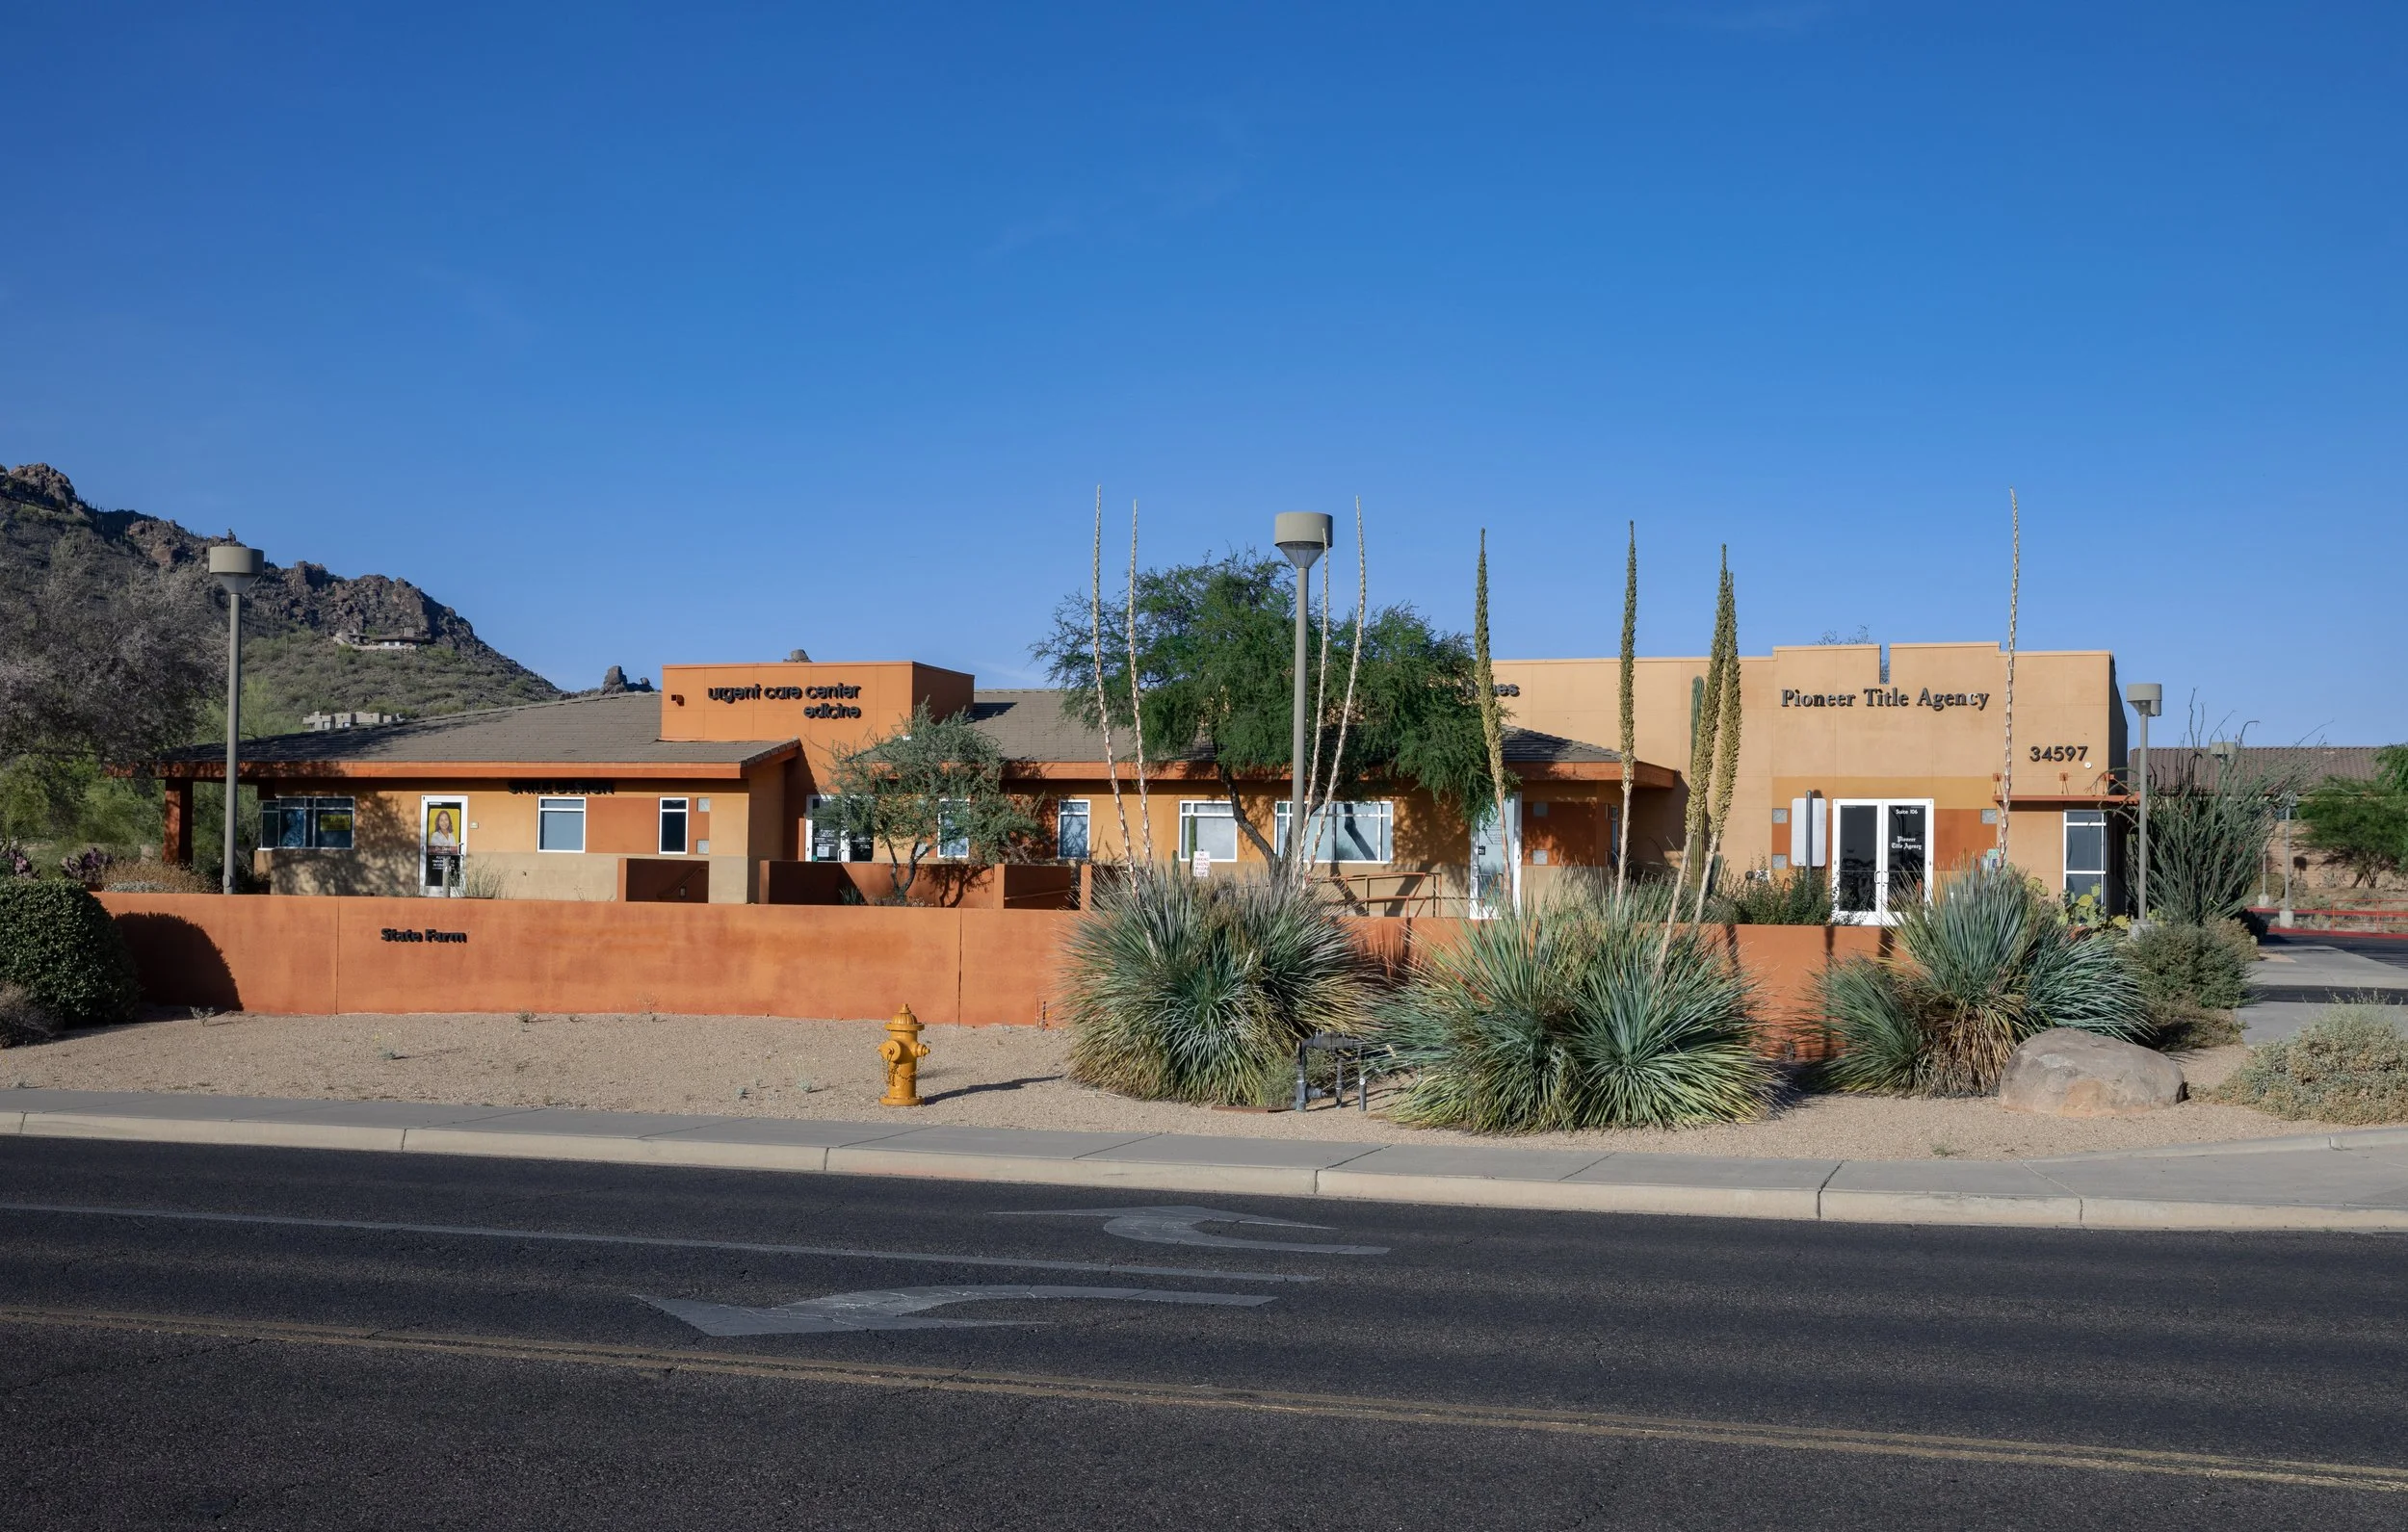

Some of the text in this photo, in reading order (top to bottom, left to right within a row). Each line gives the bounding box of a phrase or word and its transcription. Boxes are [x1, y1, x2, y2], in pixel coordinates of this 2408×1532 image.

[708, 683, 862, 704] urgent care center
[1781, 687, 1989, 712] Pioneer Title Agency
[803, 703, 862, 719] edicine
[2029, 745, 2089, 763] 34597
[381, 928, 467, 943] State Farm
